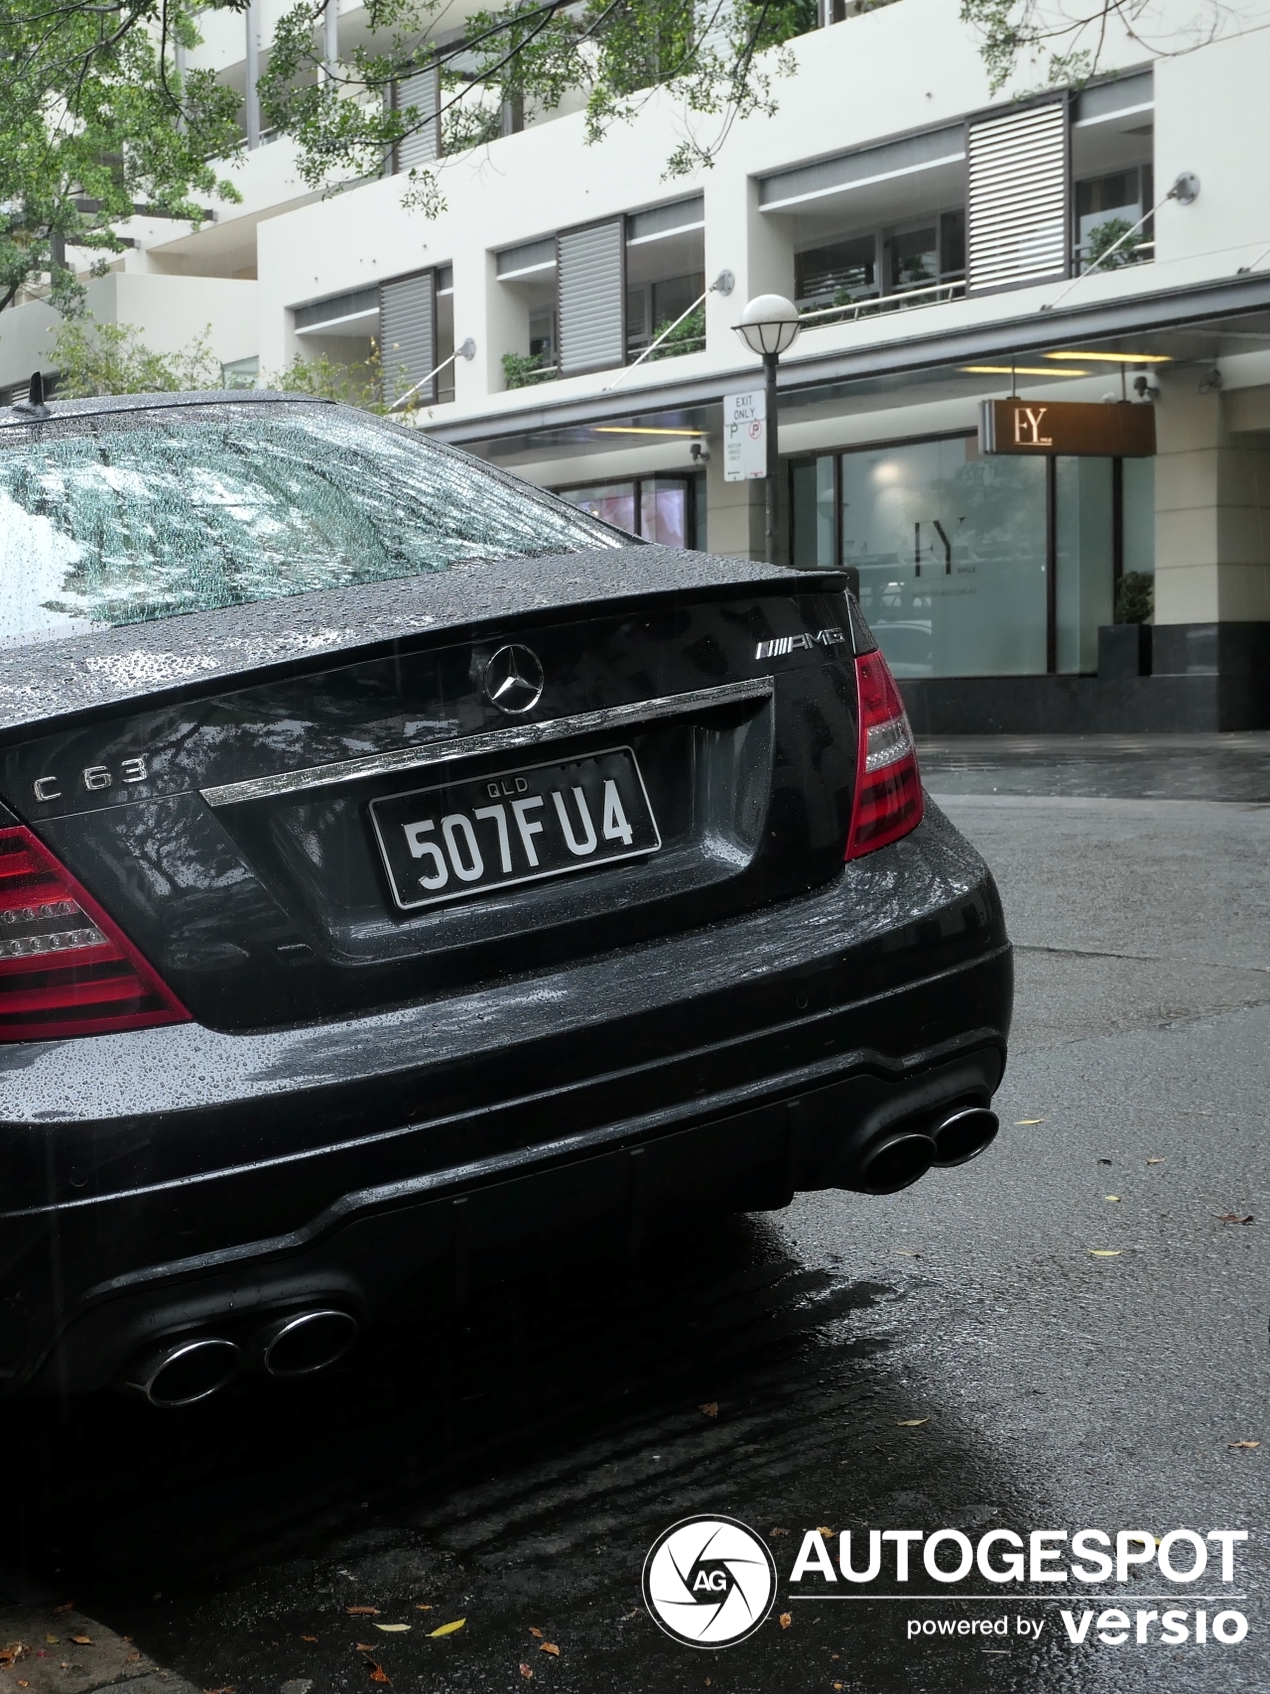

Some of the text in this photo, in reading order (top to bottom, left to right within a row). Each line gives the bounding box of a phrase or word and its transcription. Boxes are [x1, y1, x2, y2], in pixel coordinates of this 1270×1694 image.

[736, 396, 752, 407] EXIT
[734, 408, 755, 420] ONLY
[1014, 407, 1048, 443] FY
[730, 424, 738, 438] P
[33, 757, 148, 803] C 63
[486, 776, 530, 799] QLD
[401, 779, 634, 891] 507FU4
